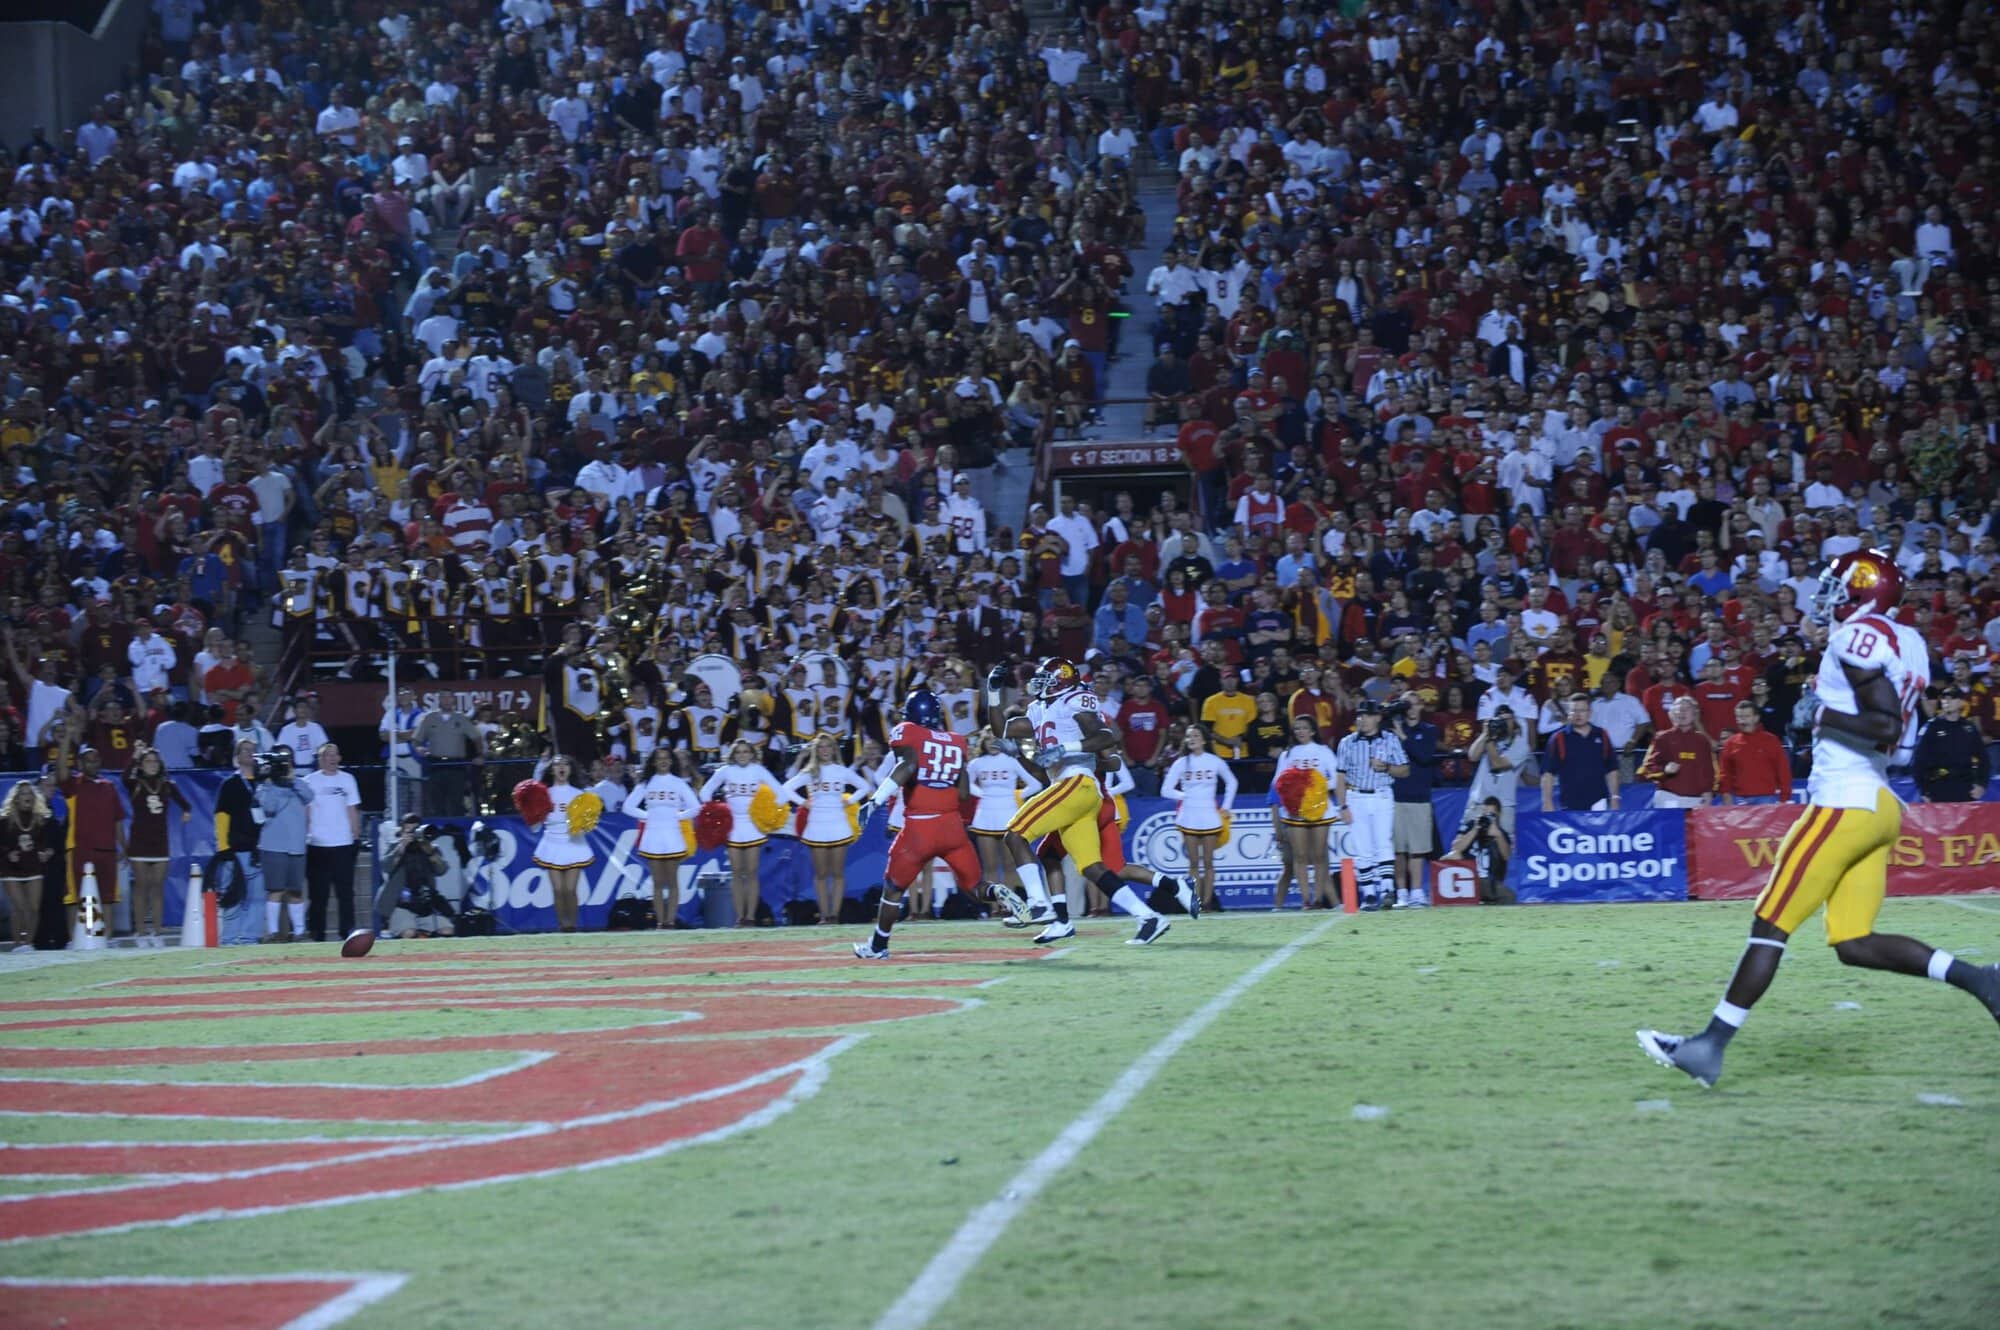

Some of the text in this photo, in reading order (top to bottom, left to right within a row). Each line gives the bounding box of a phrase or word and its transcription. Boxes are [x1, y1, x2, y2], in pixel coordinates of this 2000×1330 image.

[1100, 450, 1151, 464] SECTION
[1845, 628, 1878, 658] 18
[498, 691, 515, 710] 17
[112, 730, 127, 749] 6
[917, 740, 962, 781] 32
[1547, 827, 1655, 854] Game
[1438, 866, 1476, 898] G
[1526, 856, 1678, 888] Sponsor
[1224, 888, 1240, 896] OF
[1245, 888, 1269, 896] THE
